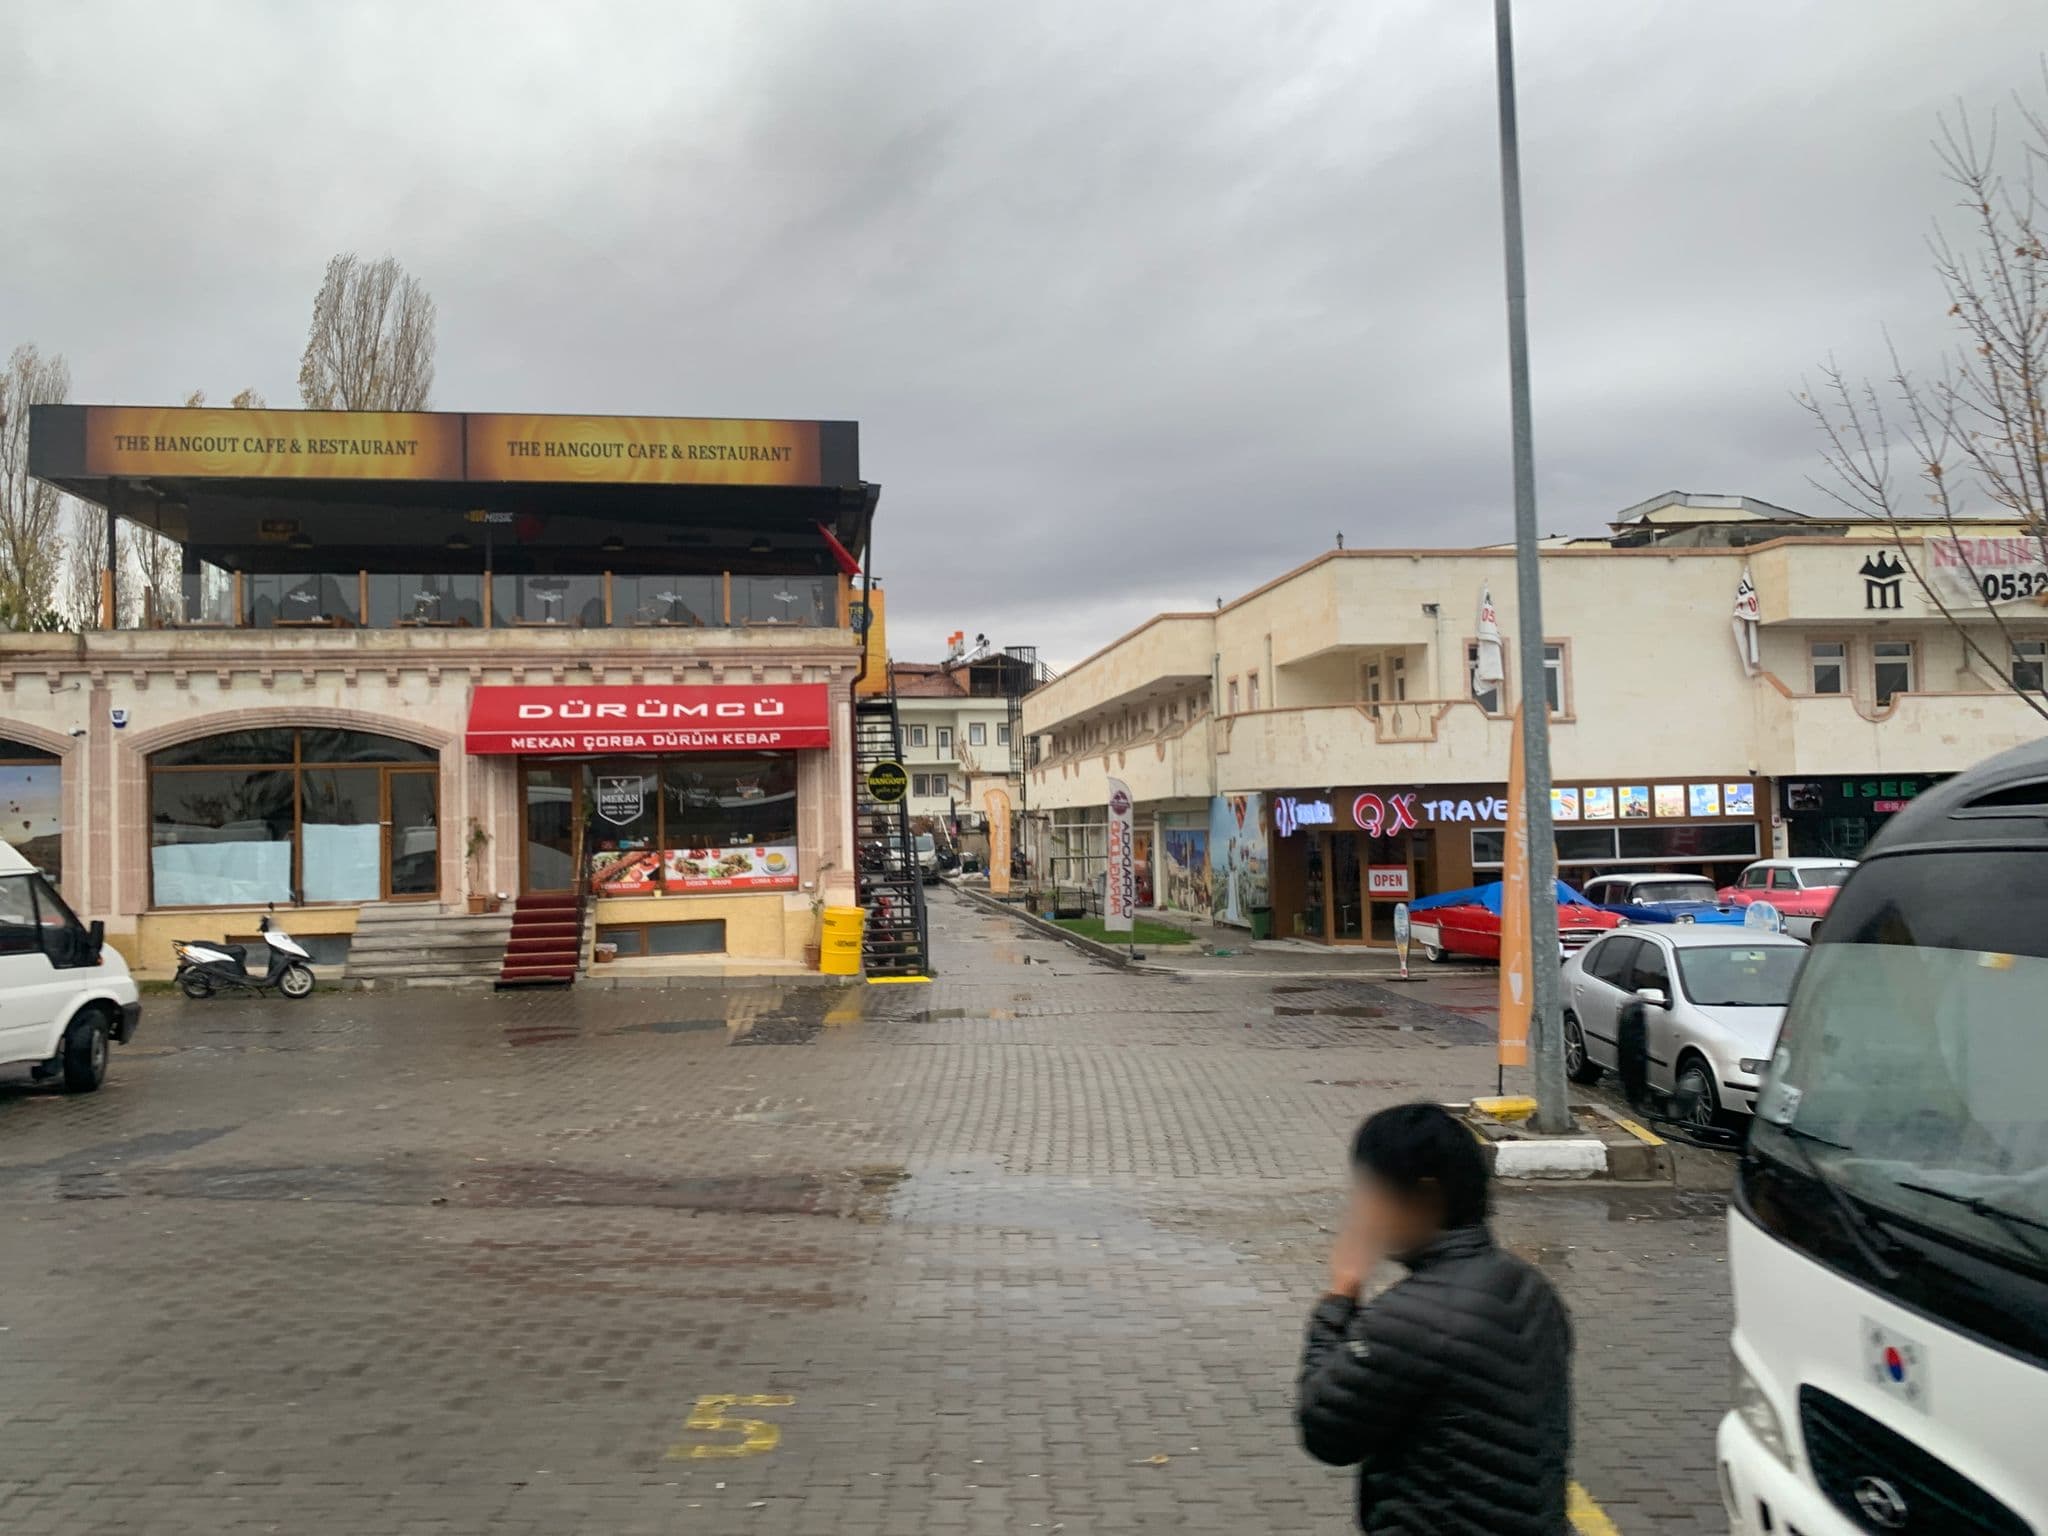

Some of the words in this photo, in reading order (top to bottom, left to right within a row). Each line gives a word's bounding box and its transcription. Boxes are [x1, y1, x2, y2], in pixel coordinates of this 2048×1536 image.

[114, 434, 150, 452] THE
[154, 436, 240, 454] HANGOUT
[243, 438, 286, 454] CAFE
[289, 440, 303, 454] &
[306, 439, 419, 456] RESTAURANT
[507, 440, 541, 457] THE
[544, 441, 625, 459] HANGOUT
[627, 443, 669, 460] CAFE
[671, 445, 683, 460] &
[687, 444, 792, 462] RESTAURANT
[518, 698, 785, 719] DÜRÜMCÜ
[511, 736, 575, 750] MEKAN
[583, 736, 647, 752] ÇORBA
[652, 731, 718, 747] DÜRÜM
[722, 732, 782, 746] KEBAP
[1352, 792, 1418, 838] QX
[1422, 796, 1509, 822] TRAVE
[1374, 873, 1403, 887] OPEN
[666, 1394, 796, 1459] 5
